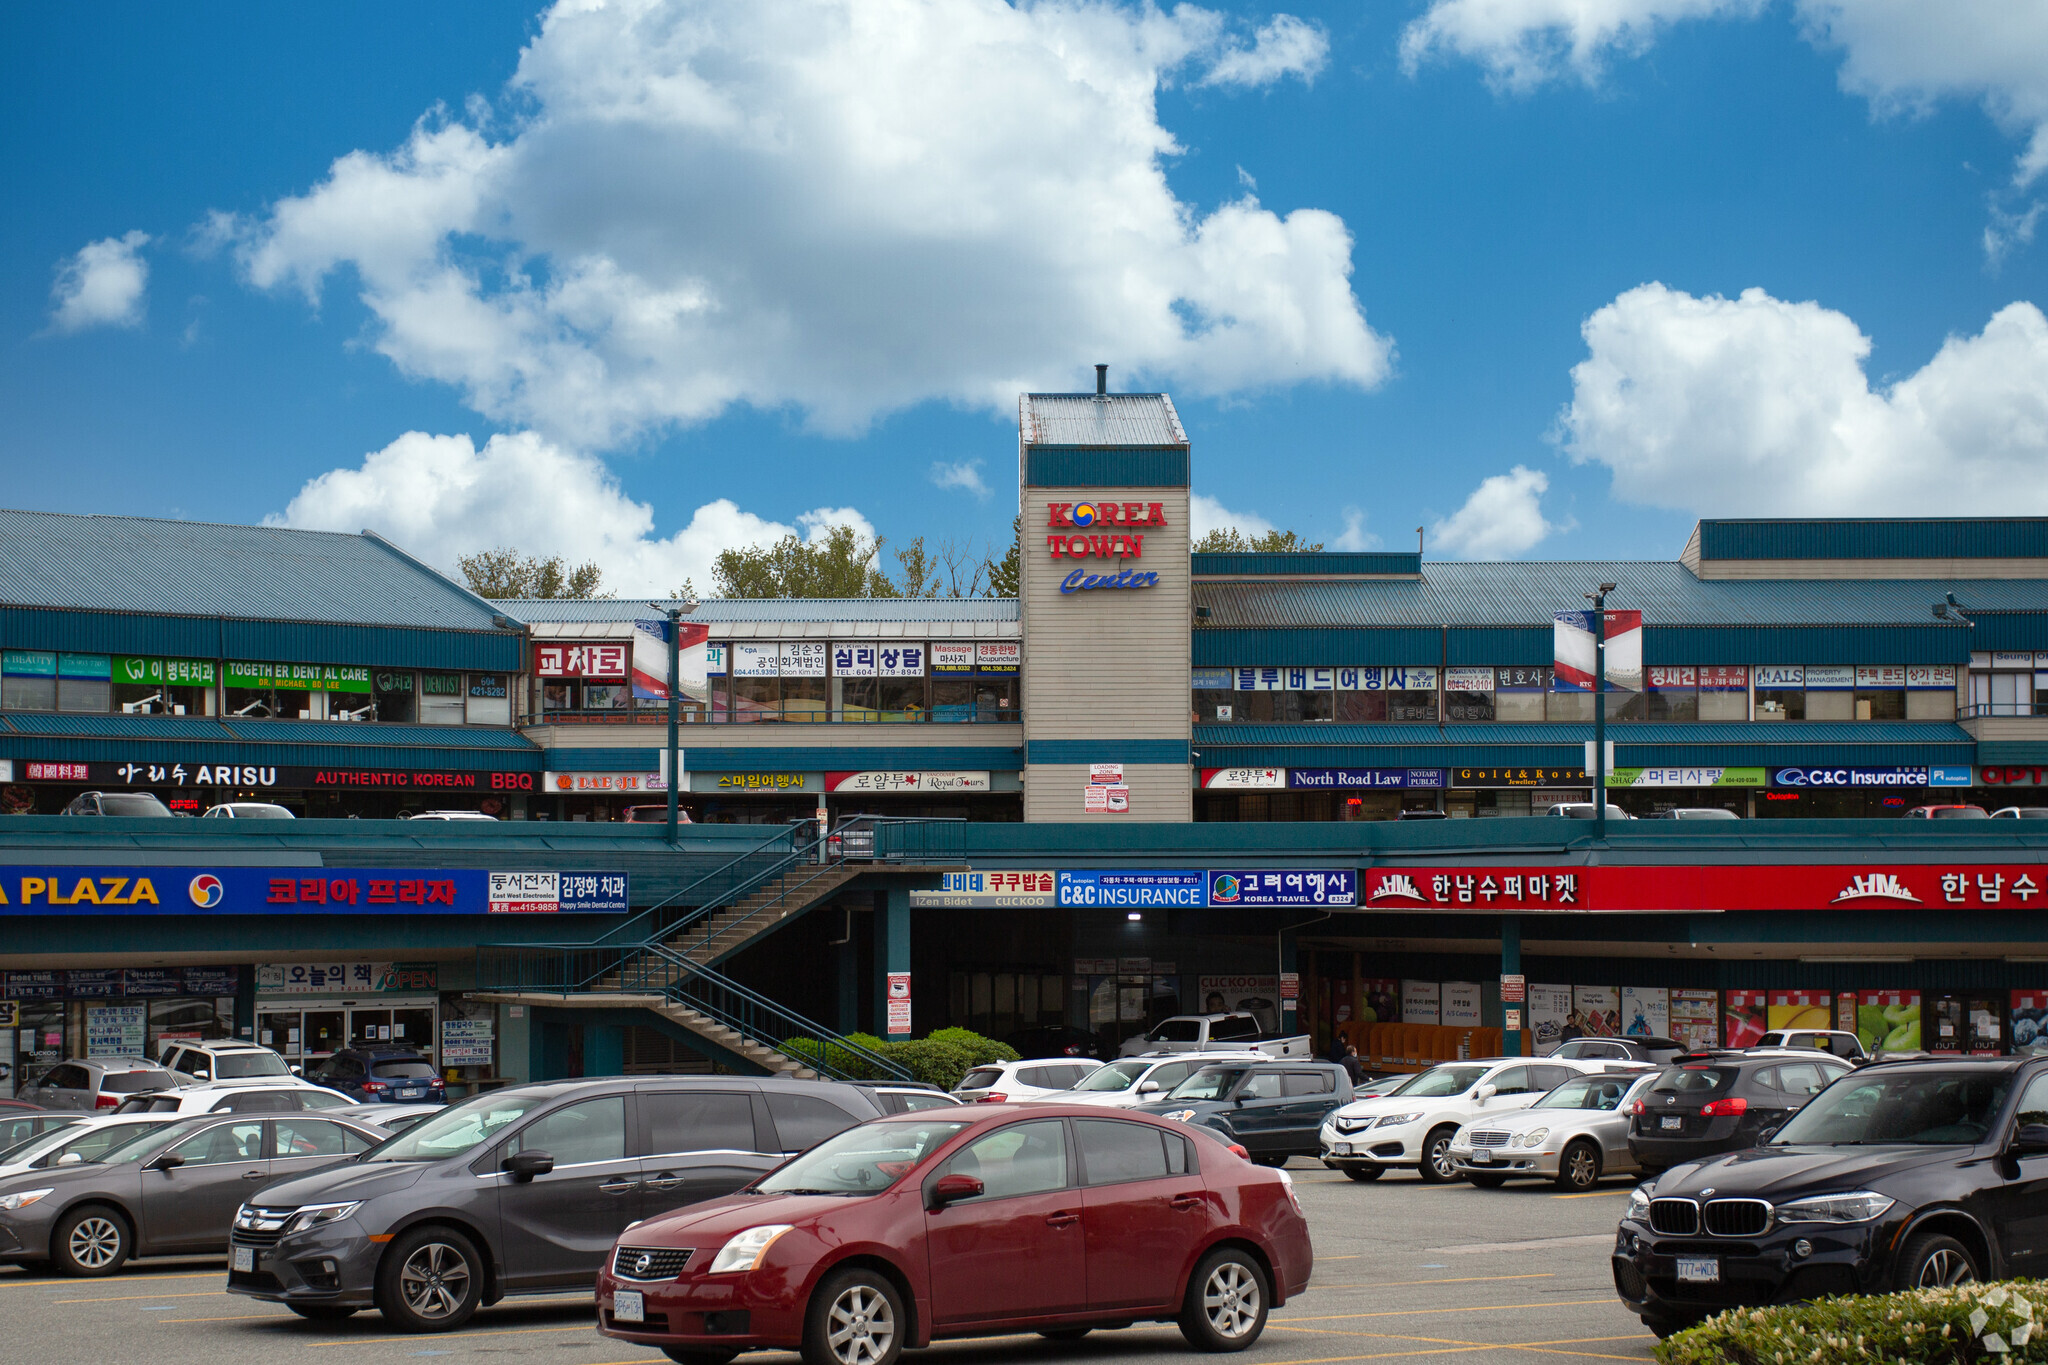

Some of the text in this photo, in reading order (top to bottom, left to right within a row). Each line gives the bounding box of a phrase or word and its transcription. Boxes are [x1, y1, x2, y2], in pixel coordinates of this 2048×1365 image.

[1047, 501, 1168, 527] KOREA
[1047, 535, 1144, 559] TOWN
[1059, 568, 1160, 594] Center
[790, 644, 824, 656] 김순오
[935, 645, 972, 654] Massage
[1996, 652, 2031, 661] Seung
[12, 656, 53, 665] BEAUTY
[539, 646, 626, 676] 교차로
[835, 649, 921, 669] 심리상담
[940, 654, 966, 663] 마사지
[229, 662, 368, 682] TOGETHER DENTAL CARE
[1499, 669, 1543, 686] 변호사
[1772, 669, 1803, 683] ALS
[276, 679, 308, 688] MICHAEL
[326, 681, 341, 689] LEE
[424, 674, 461, 695] DENTIST
[480, 677, 495, 687] 604
[1412, 681, 1433, 689] IATA
[471, 686, 506, 697] 421-8282
[28, 764, 88, 779] 韓國料理
[195, 766, 276, 786] ARISU
[1294, 771, 1402, 785] North Road Law
[1649, 769, 1722, 784] 머리사랑
[1809, 769, 1927, 785] C&C Insurance
[315, 771, 533, 790] AUTHENTIC KOREAN BBQ
[718, 774, 805, 788] 스마일여행사
[927, 776, 954, 790] Royal
[1508, 778, 1537, 786] Jewellery
[1610, 777, 1646, 785] SHAGGY
[170, 799, 198, 809] OPEN
[490, 874, 557, 890] 동서전자
[562, 876, 625, 898] 김정화 치과
[989, 873, 1054, 892] 쿠쿠밥솥
[1244, 873, 1347, 902] 고려여행사
[1431, 874, 1579, 903] 한남수퍼마켓
[1940, 873, 2047, 903] 한남수
[21, 877, 160, 905] PLAZA
[266, 878, 457, 906] 코리아 프라자
[1060, 885, 1201, 905] C&C INSURANCE
[491, 902, 510, 912] 東西
[520, 903, 558, 911] 415-9858
[560, 902, 577, 910] Happy
[916, 897, 973, 906] iZen Bidet
[995, 897, 1045, 906] CUCKOO
[288, 964, 346, 987] 오늘의
[354, 964, 372, 986] 책
[384, 971, 437, 989] OPEN
[1201, 977, 1257, 988] CUCKOO
